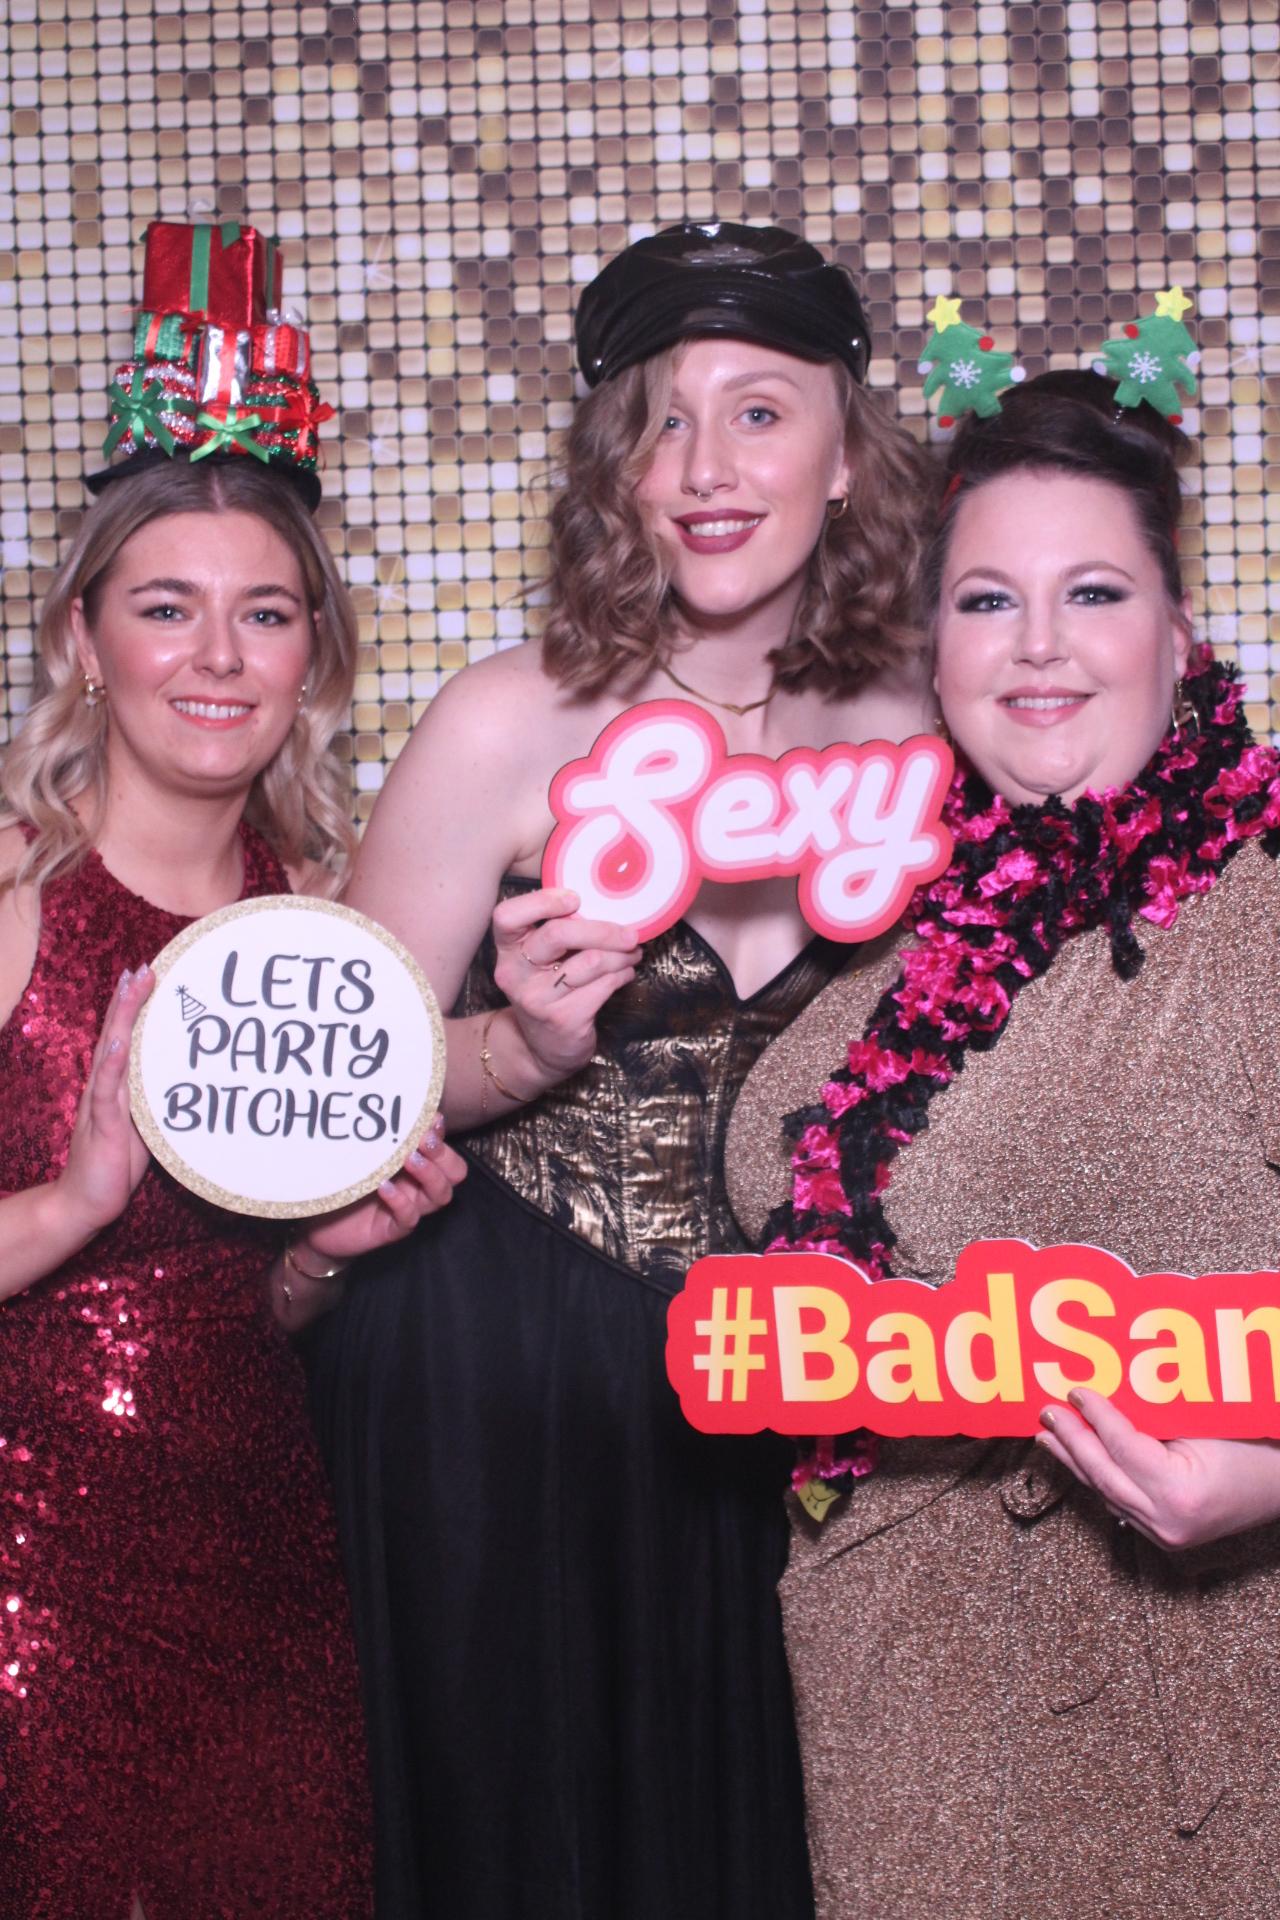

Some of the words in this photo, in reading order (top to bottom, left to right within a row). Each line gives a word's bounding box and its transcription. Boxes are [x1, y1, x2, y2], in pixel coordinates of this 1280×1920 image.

[559, 719, 936, 927] Sexy
[221, 950, 375, 1015] LETS
[163, 1082, 402, 1144] BITCHES!
